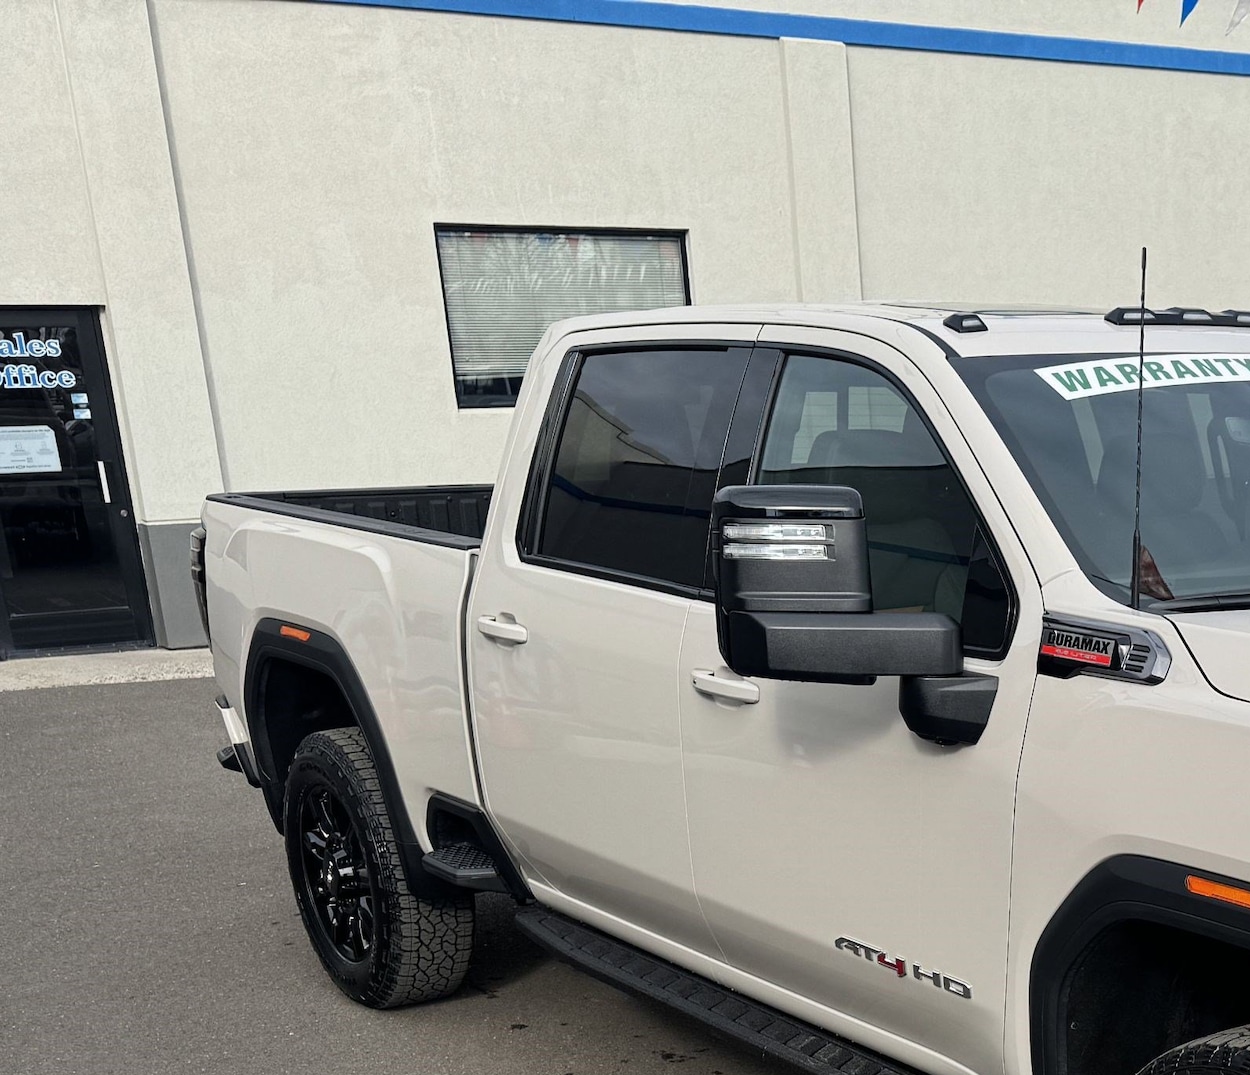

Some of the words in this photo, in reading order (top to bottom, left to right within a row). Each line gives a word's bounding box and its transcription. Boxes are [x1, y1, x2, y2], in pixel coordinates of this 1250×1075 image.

[0, 332, 62, 357] ales
[0, 364, 77, 389] ffice
[1048, 630, 1111, 655] DURAMAX
[834, 934, 907, 978] AT4
[912, 961, 973, 999] HD
